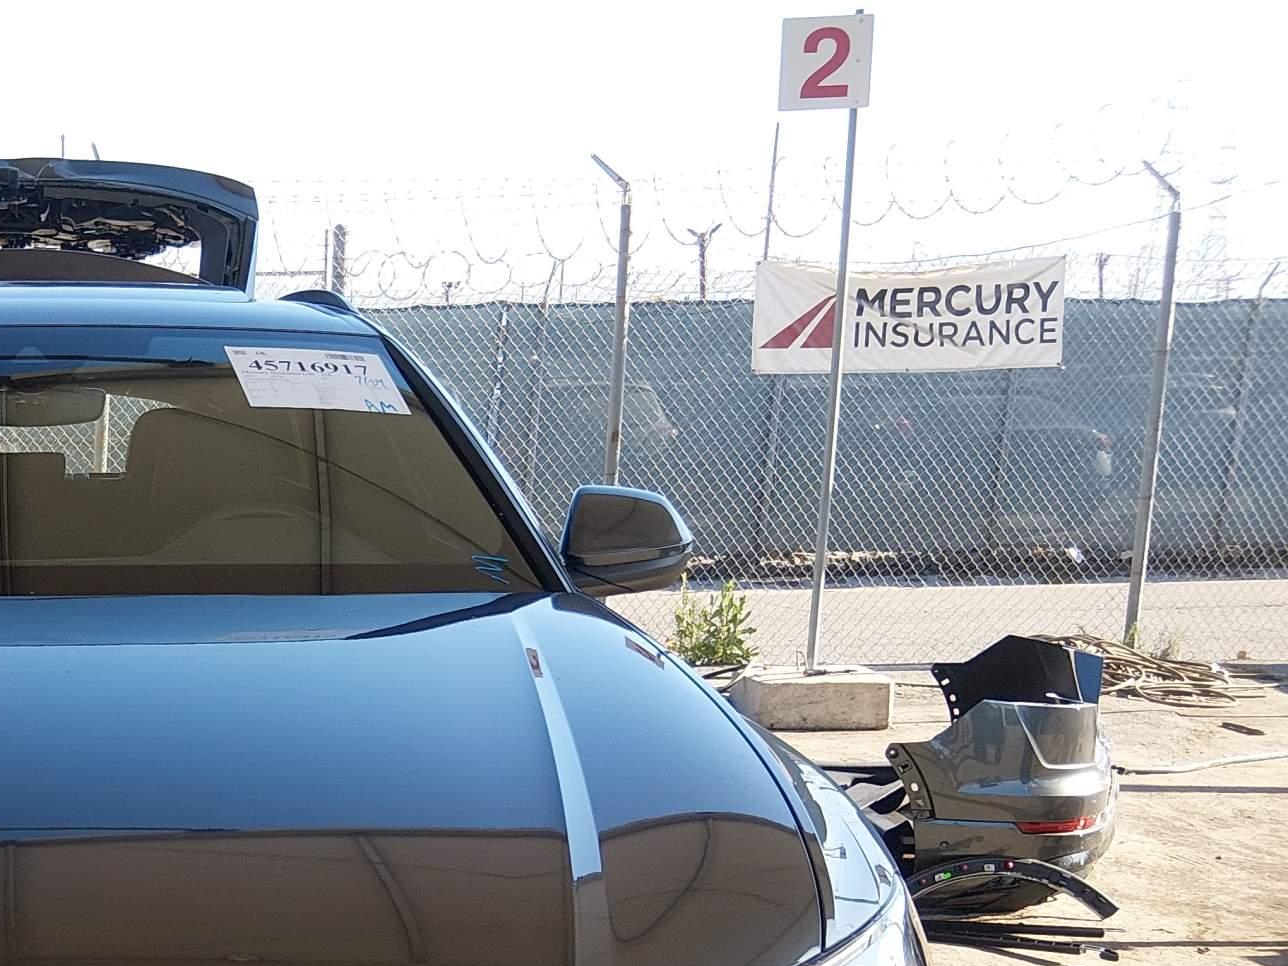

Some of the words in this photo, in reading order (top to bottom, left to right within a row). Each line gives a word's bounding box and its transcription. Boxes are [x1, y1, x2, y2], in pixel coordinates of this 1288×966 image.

[799, 26, 851, 99] 2
[854, 280, 1060, 319] MERCURY
[853, 317, 1058, 348] INSURANCE
[248, 359, 368, 377] 45716917
